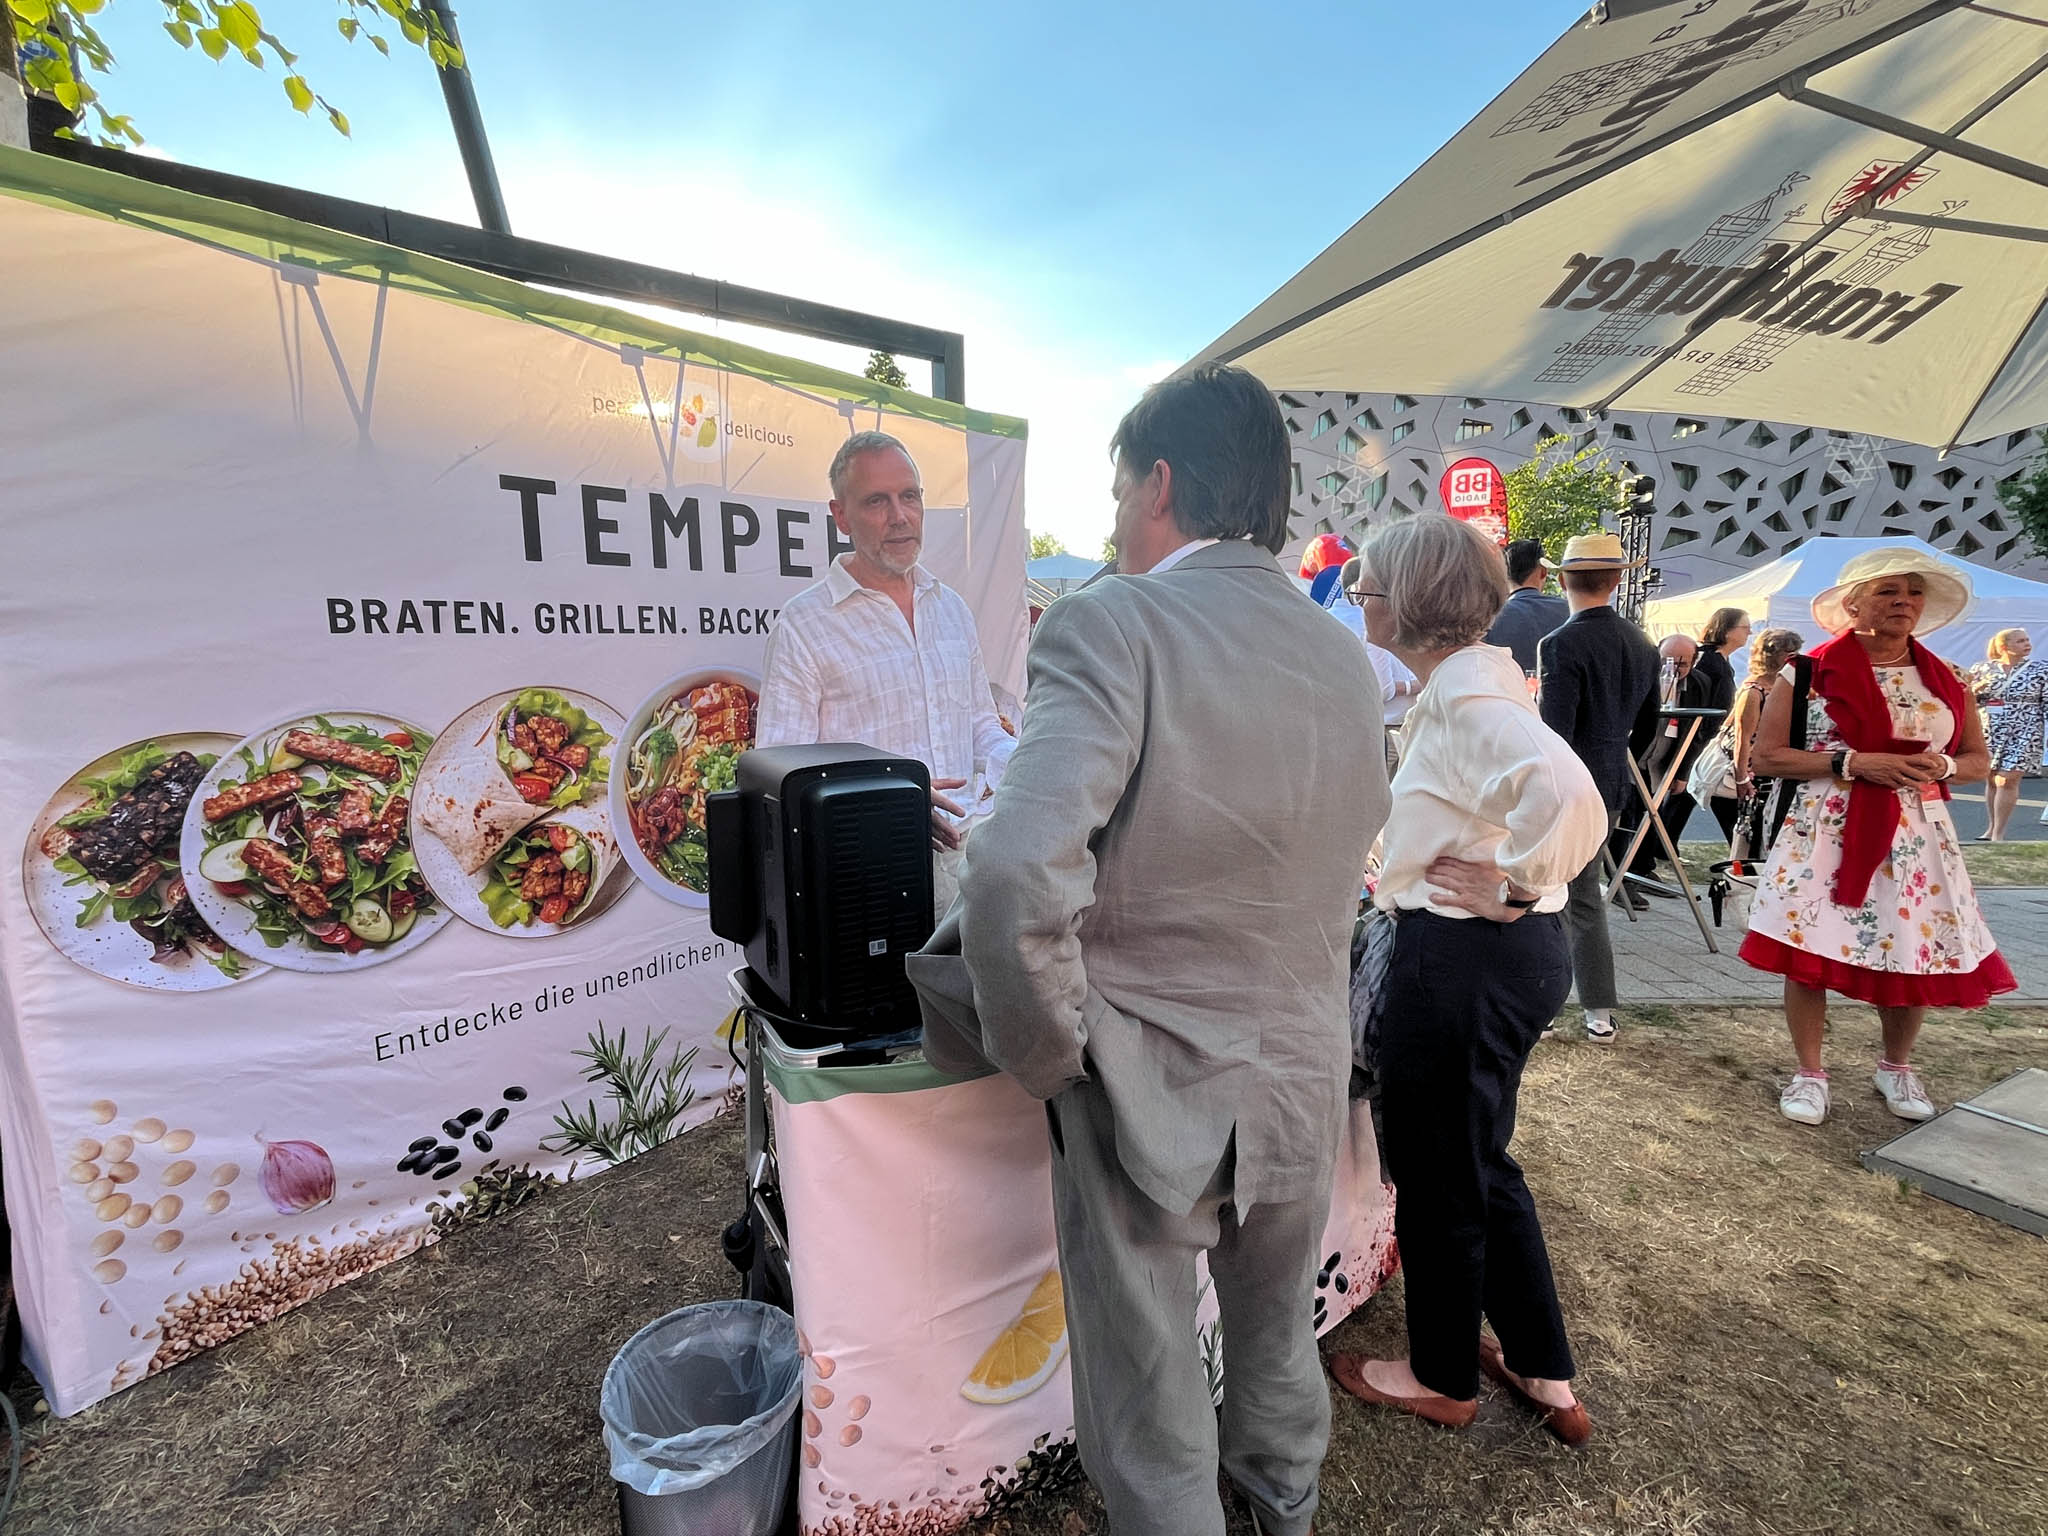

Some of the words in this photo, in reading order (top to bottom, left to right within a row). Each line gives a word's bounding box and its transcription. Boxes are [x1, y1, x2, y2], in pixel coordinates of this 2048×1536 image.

[725, 421, 794, 447] delicious
[327, 597, 519, 634] BRATEN.
[534, 603, 687, 634] GRILLEN.
[699, 607, 781, 635] BACK
[374, 1002, 523, 1061] Entdecke
[535, 984, 574, 1013] die
[585, 941, 725, 997] unendlichen
